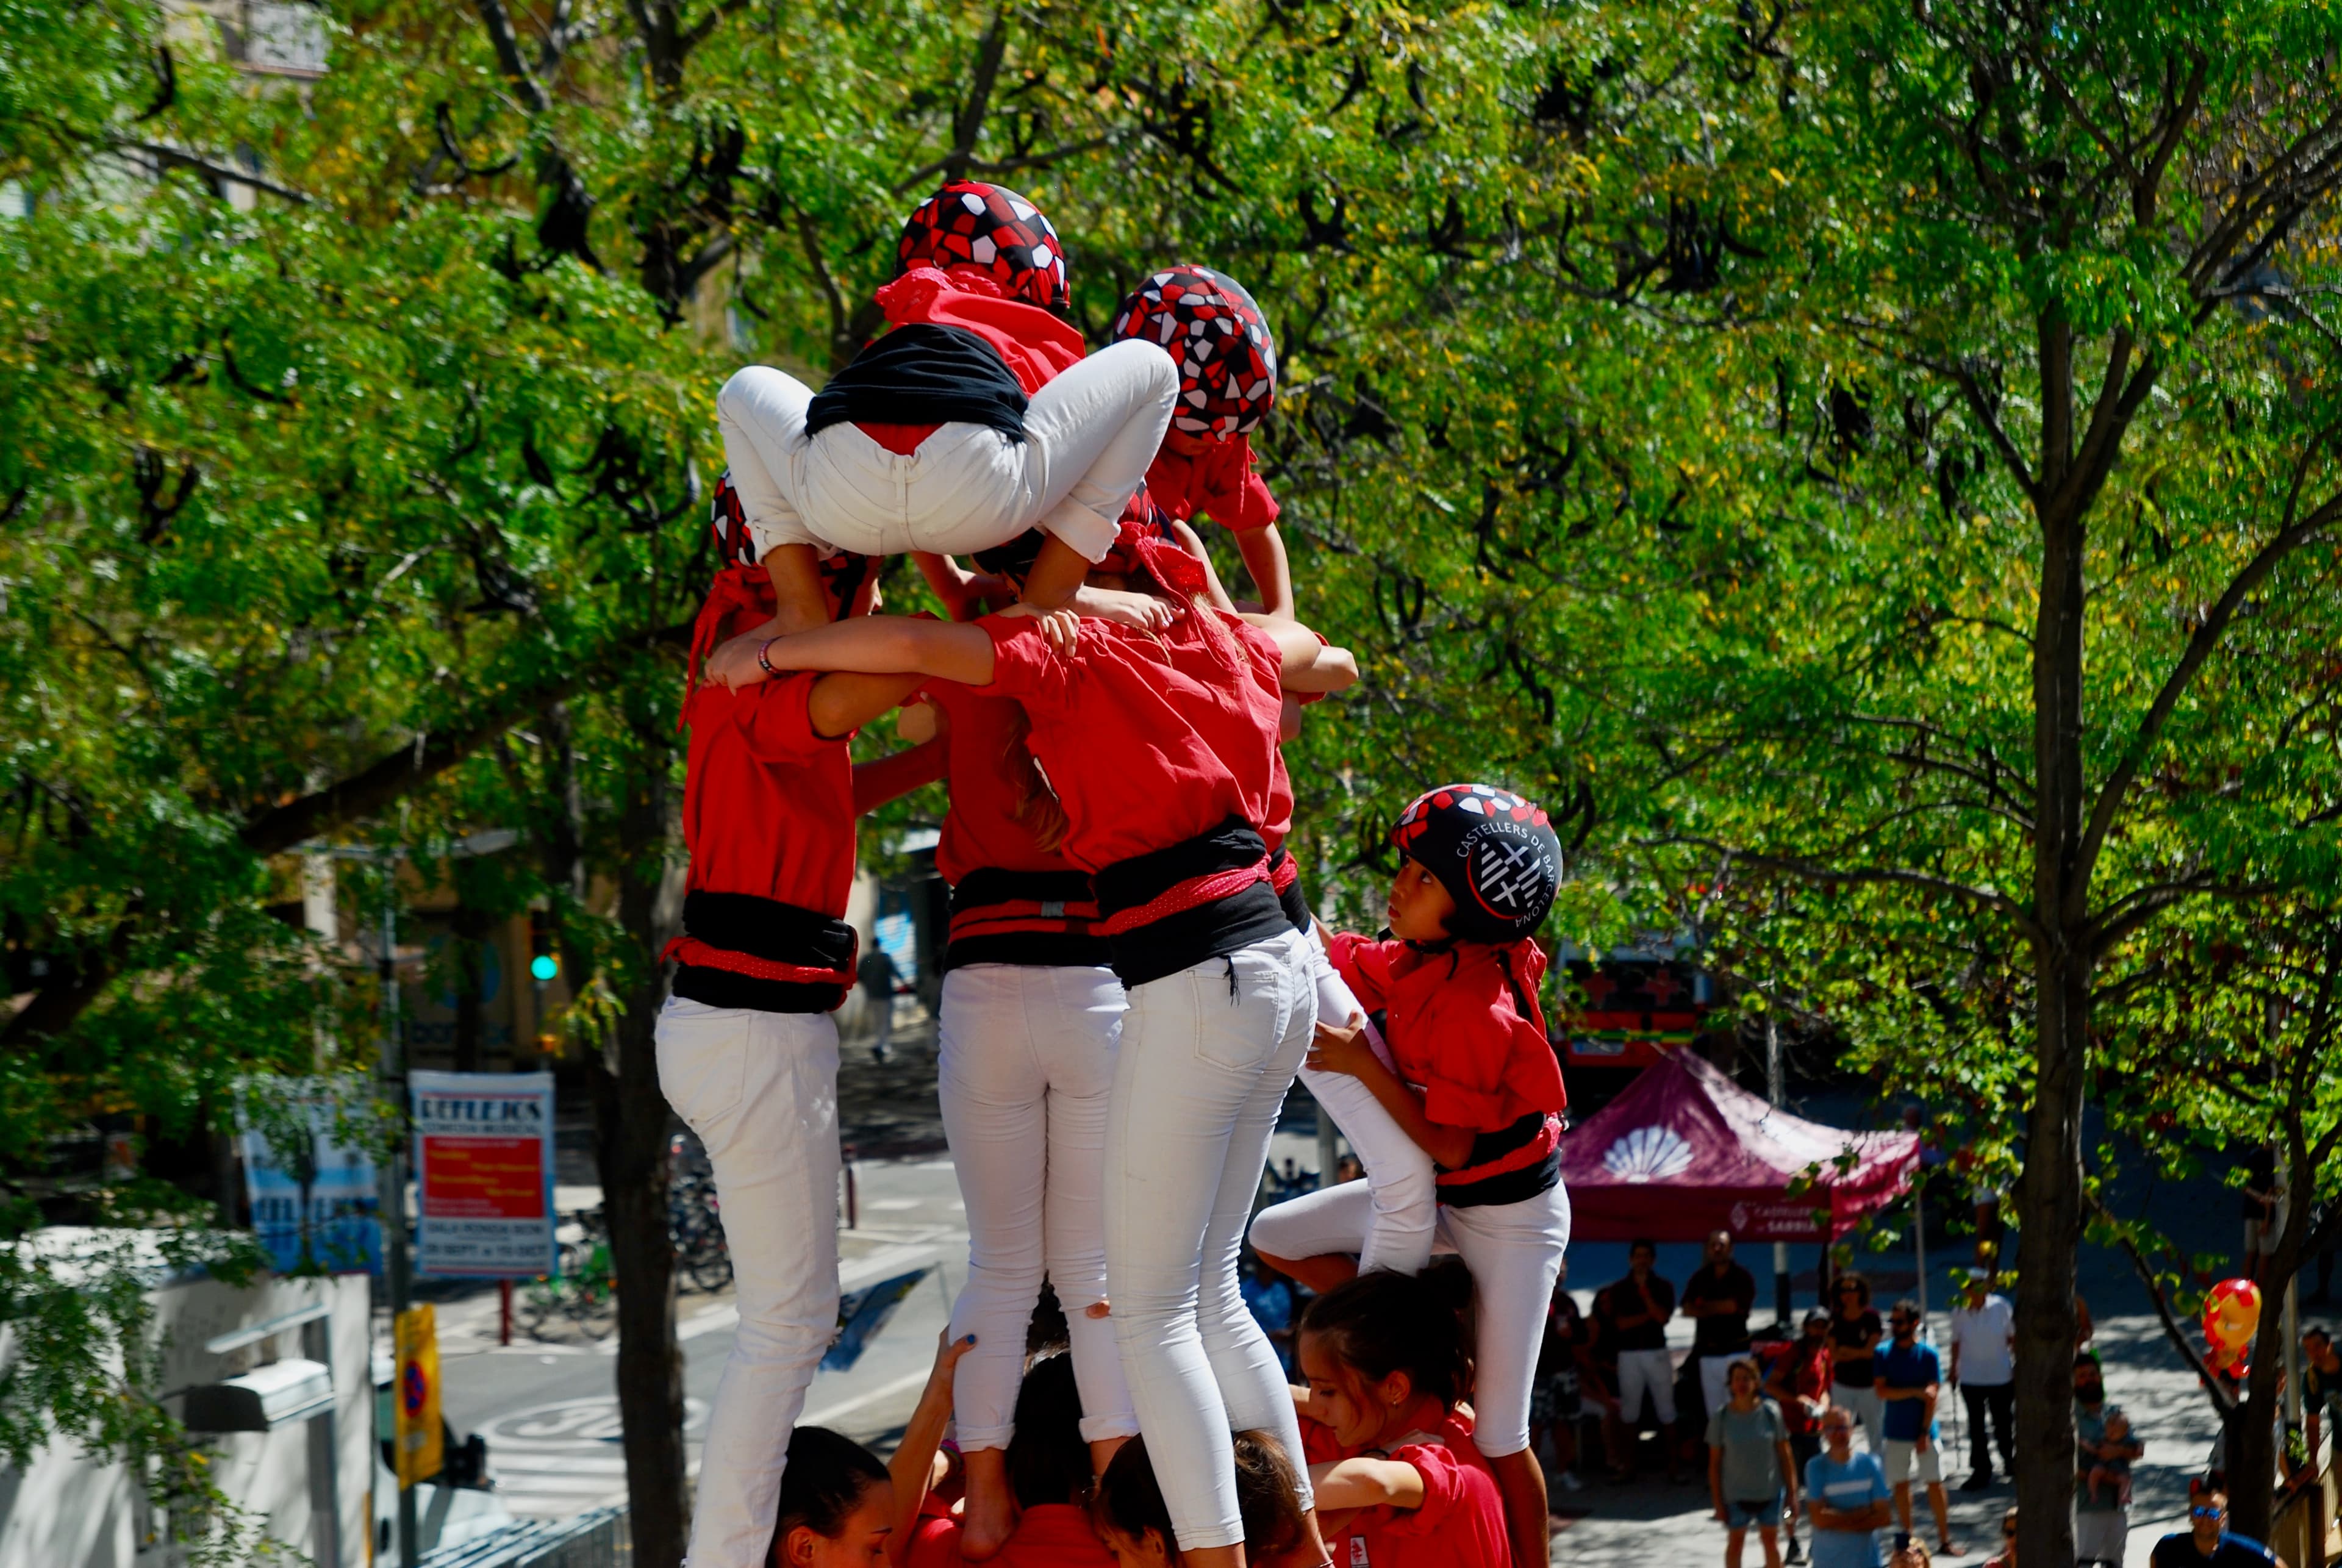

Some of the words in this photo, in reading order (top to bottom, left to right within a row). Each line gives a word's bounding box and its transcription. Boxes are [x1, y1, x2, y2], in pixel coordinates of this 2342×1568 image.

[1456, 822, 1528, 858] CASTELLERS
[1530, 834, 1545, 854] DE
[1515, 854, 1555, 928] BARCELONA
[421, 1099, 542, 1120] REFLEJOS
